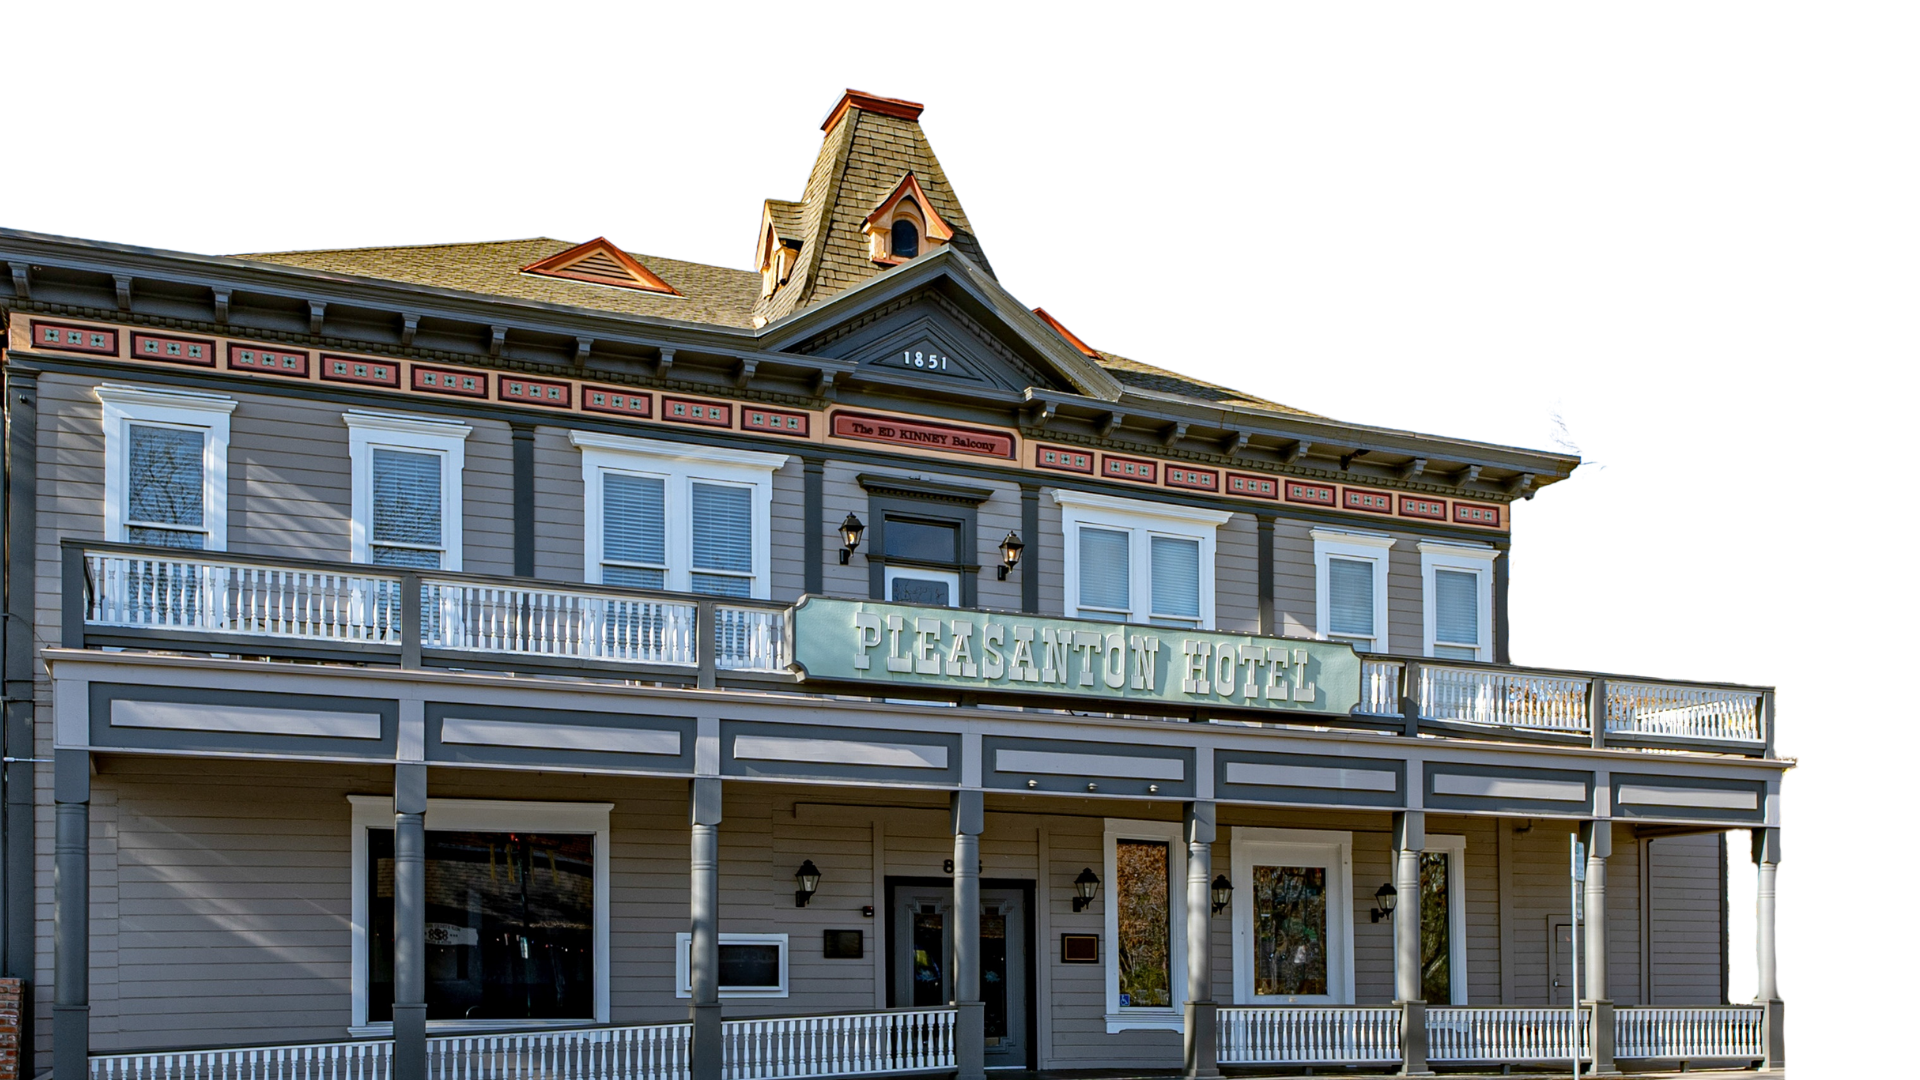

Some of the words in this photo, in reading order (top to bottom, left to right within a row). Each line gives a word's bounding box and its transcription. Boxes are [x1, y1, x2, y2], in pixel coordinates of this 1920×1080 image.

[904, 351, 947, 370] 1851
[852, 422, 873, 436] The
[878, 426, 895, 438] ED
[899, 429, 948, 445] KINNEY
[952, 436, 996, 453] Balcony
[854, 612, 1159, 691] PLEASANTON
[1184, 639, 1316, 703] HOTEL
